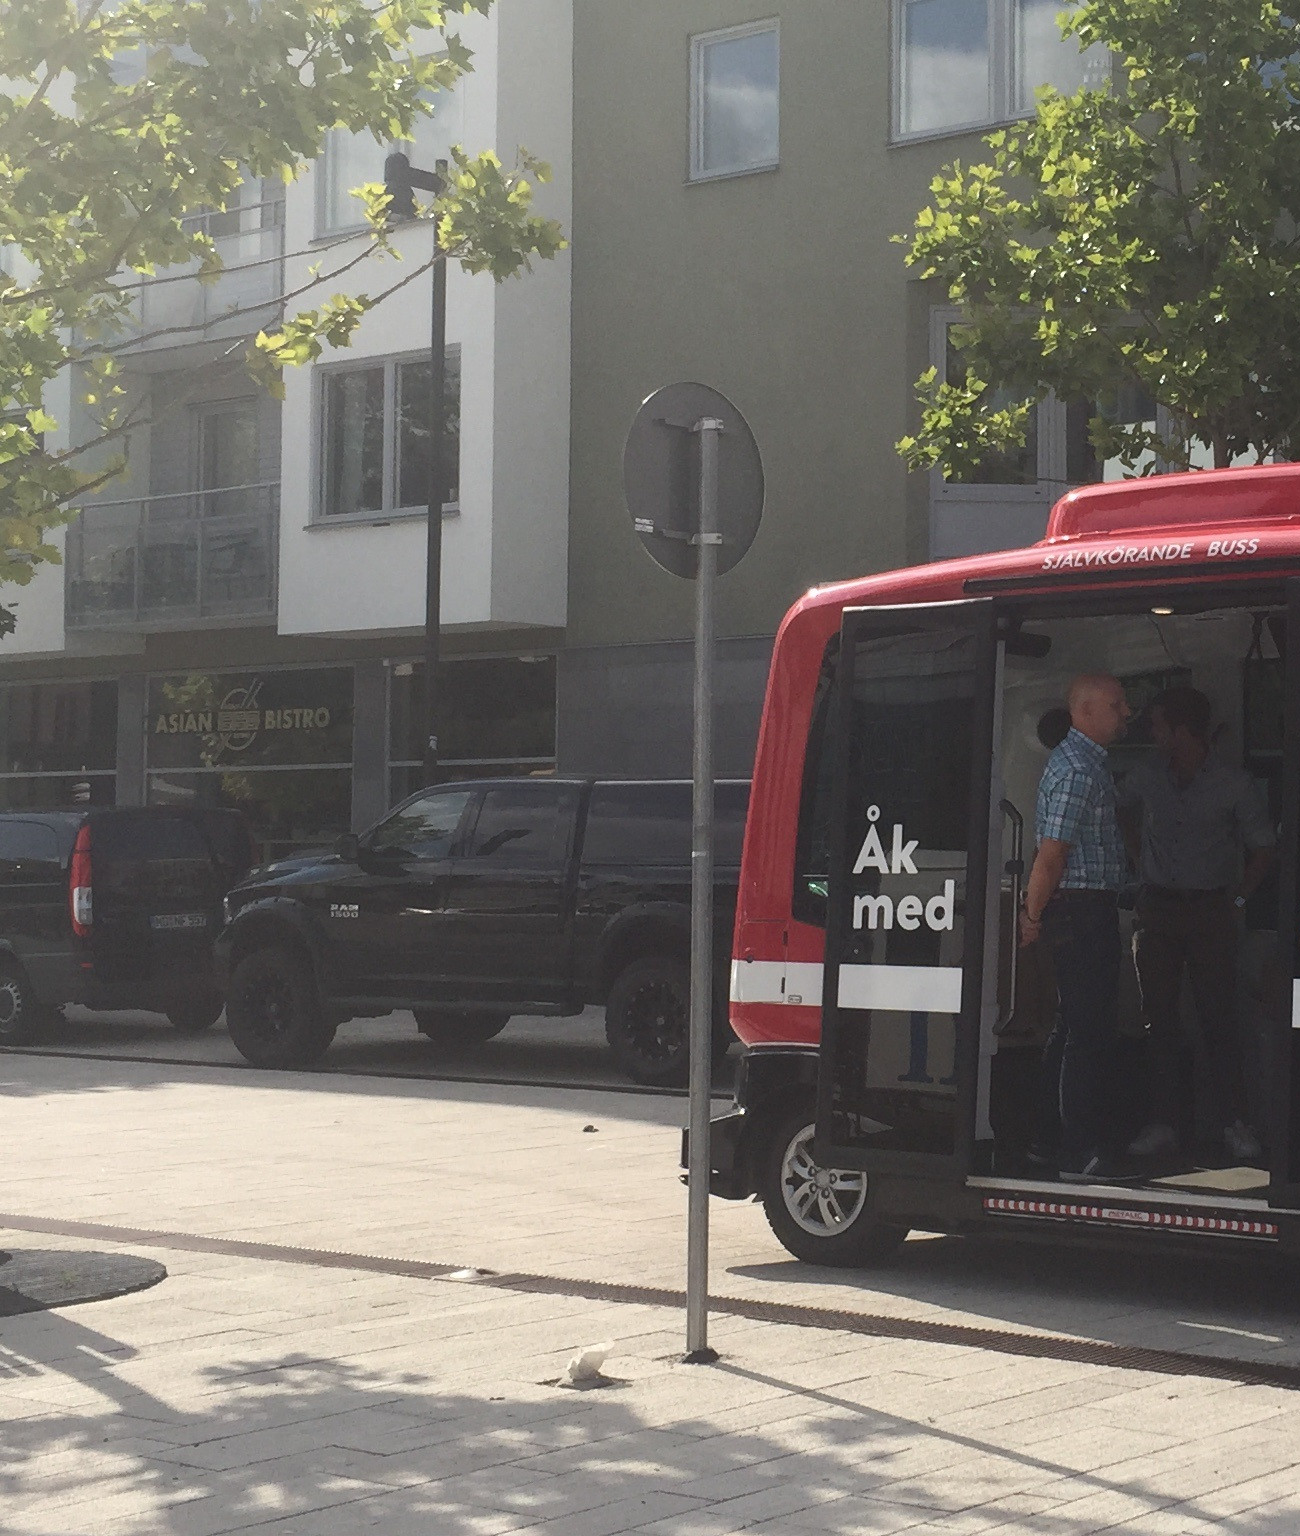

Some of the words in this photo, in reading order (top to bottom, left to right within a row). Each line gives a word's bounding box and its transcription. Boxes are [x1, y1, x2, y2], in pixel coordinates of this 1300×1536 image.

[1042, 543, 1195, 569] SJÄLVKÖRANDE
[1206, 538, 1260, 557] BUSS
[155, 712, 213, 734] ASIAN
[265, 707, 330, 730] BISTRO
[852, 804, 919, 874] Åk
[853, 879, 955, 931] med
